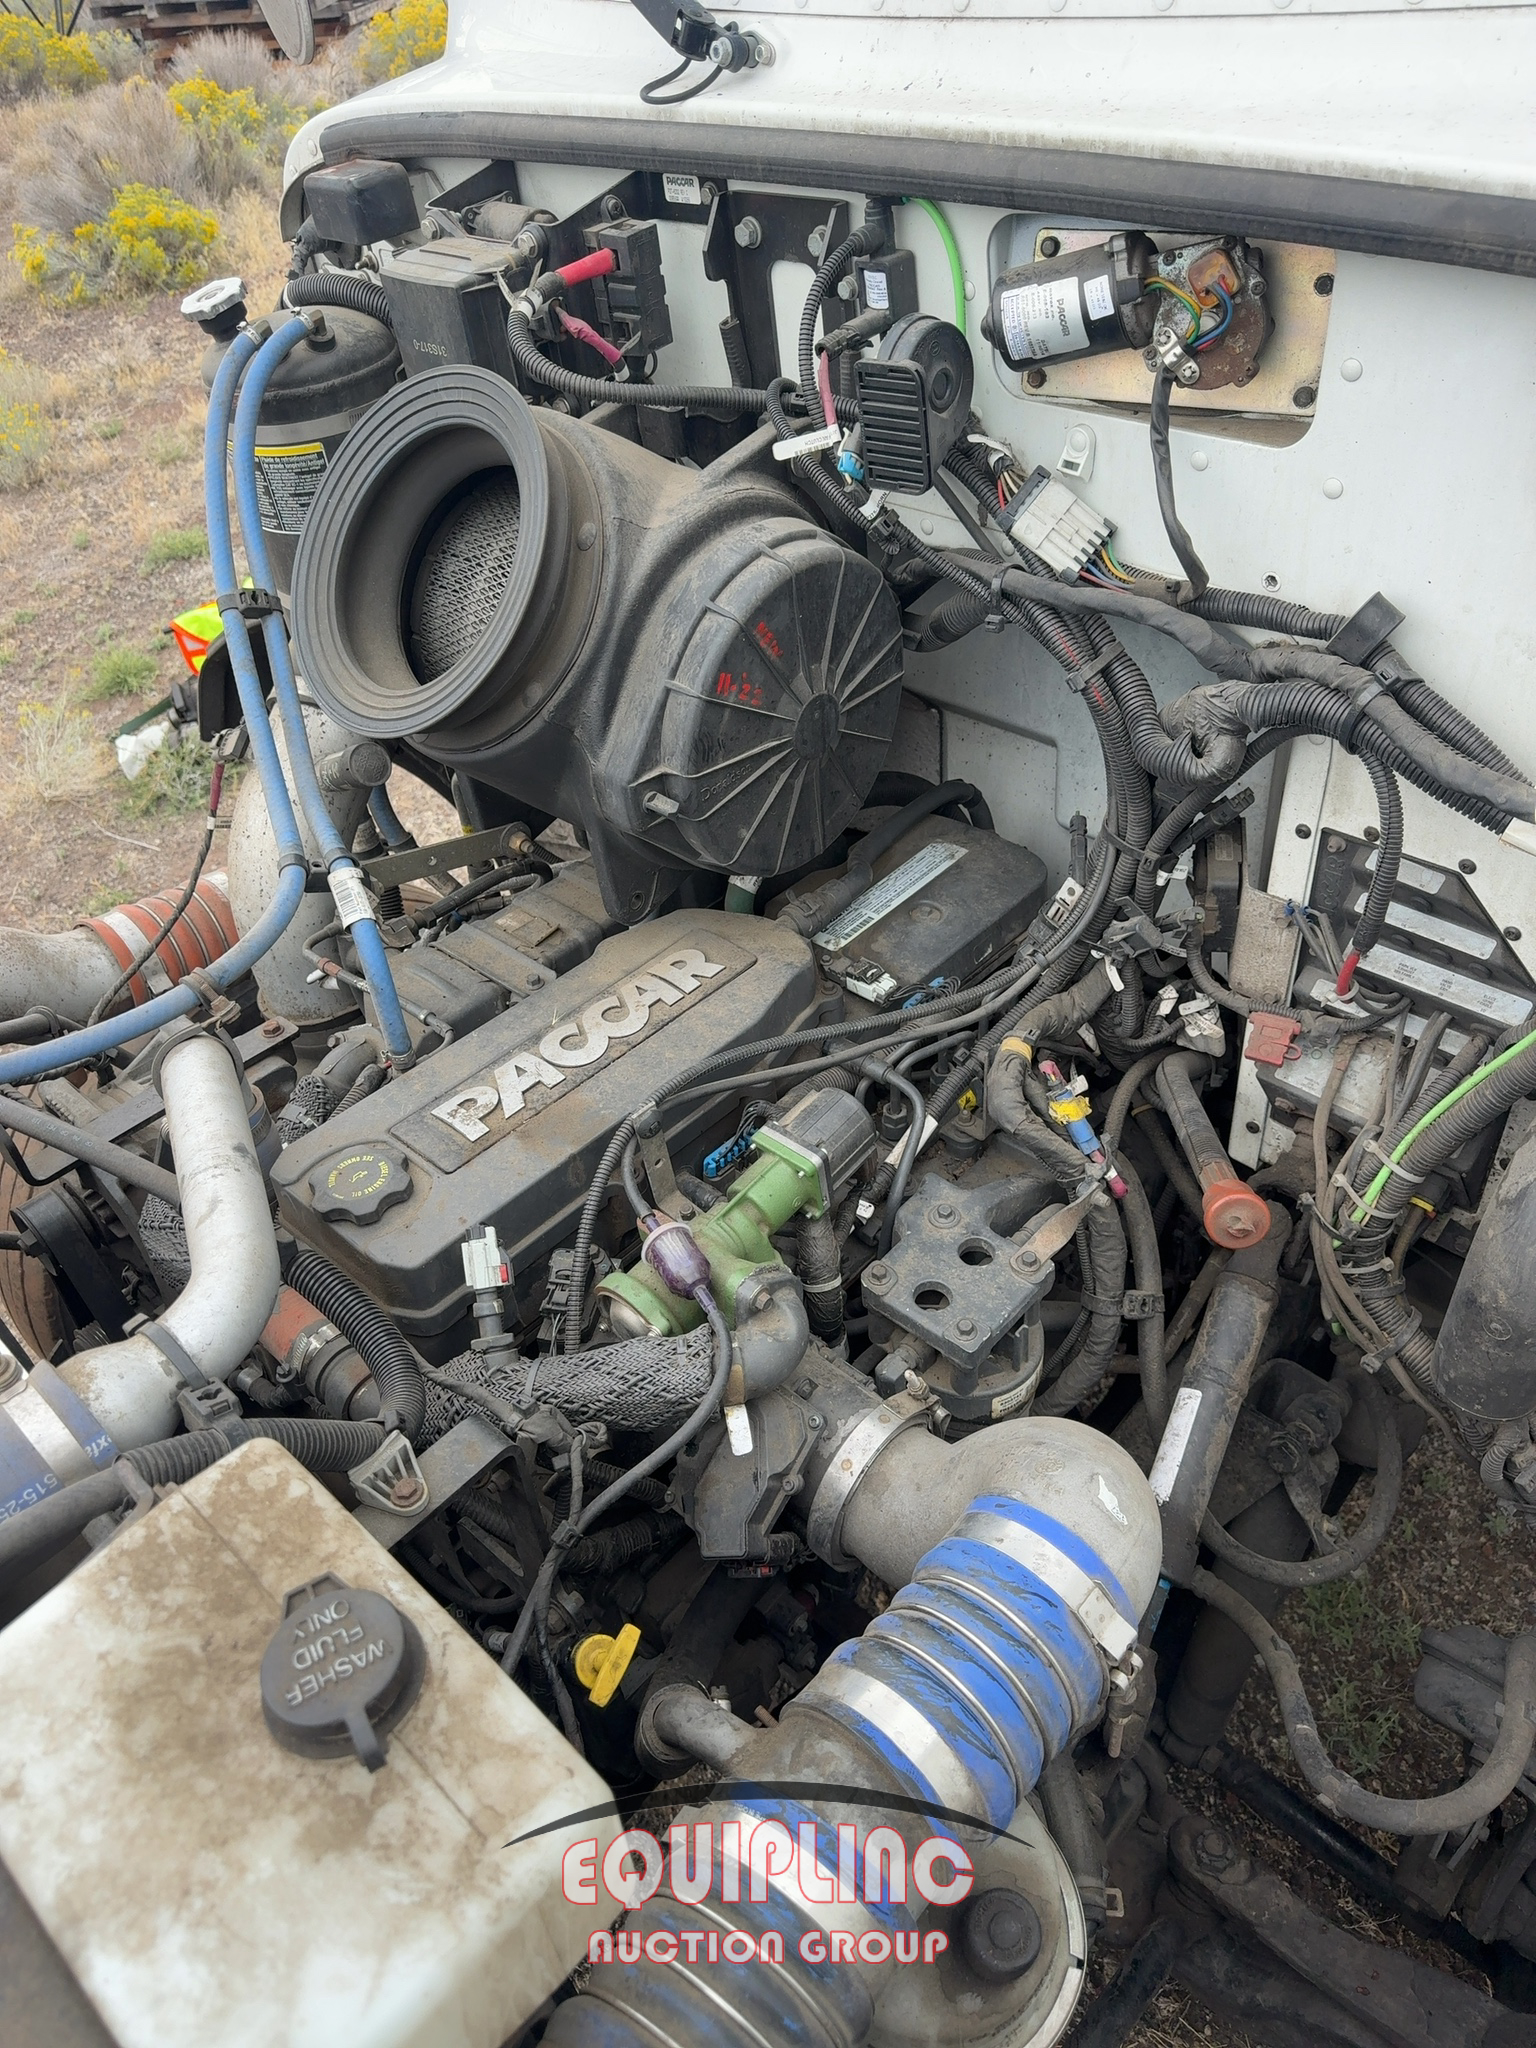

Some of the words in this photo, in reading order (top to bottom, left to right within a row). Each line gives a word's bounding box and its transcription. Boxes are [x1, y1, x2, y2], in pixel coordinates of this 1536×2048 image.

[666, 176, 695, 187] PACCAR
[1056, 298, 1070, 337] PACCAR
[700, 764, 754, 802] Donaldson
[430, 946, 727, 1144] PACCAR
[365, 1178, 386, 1195] ENGINE
[294, 1600, 348, 1645] ONLY
[294, 1624, 364, 1672] FLUID
